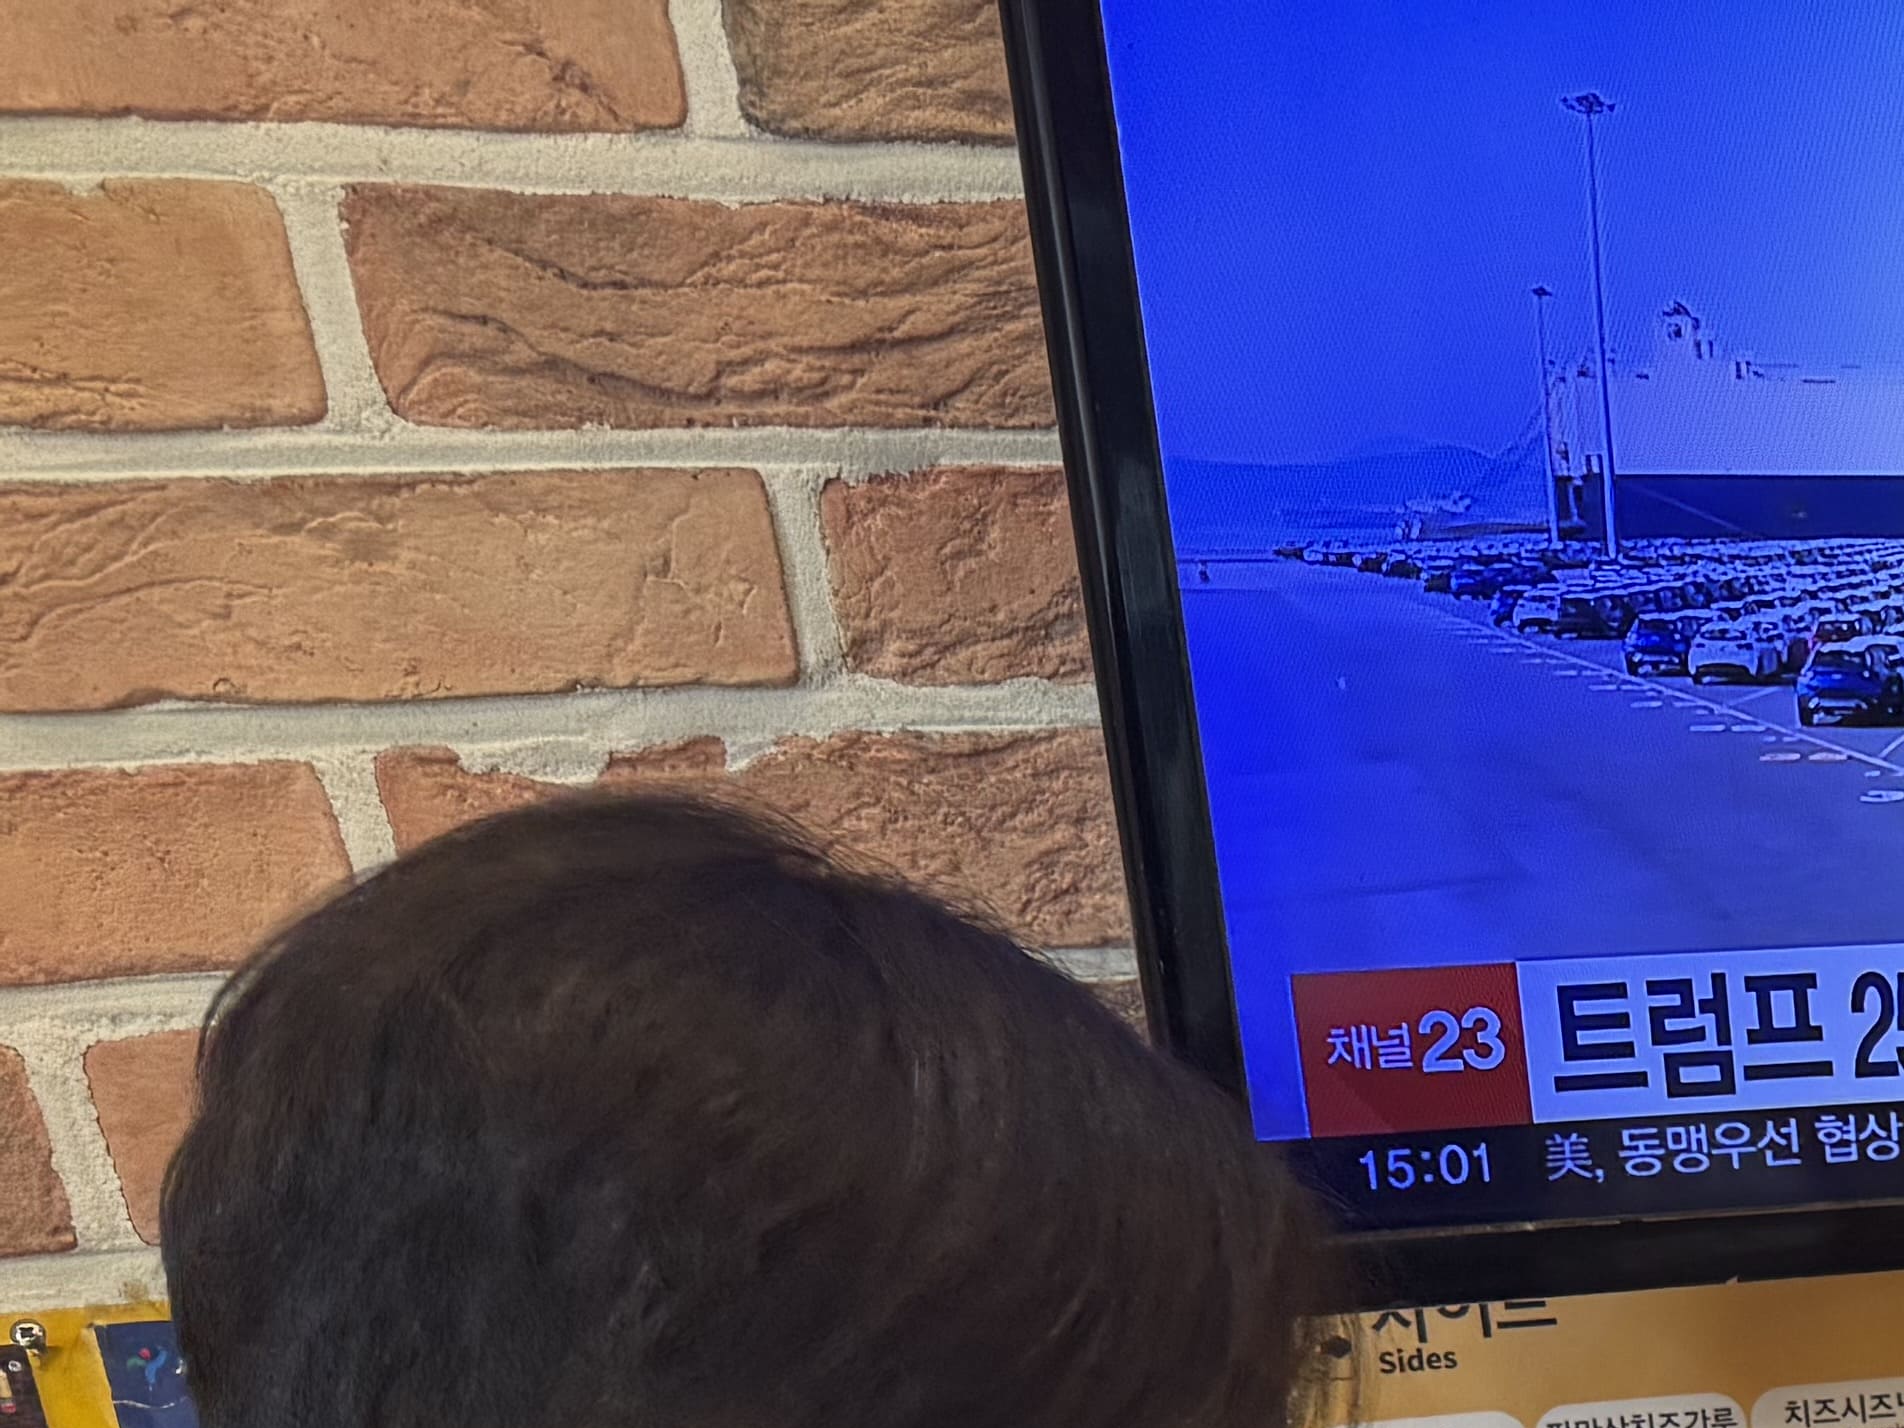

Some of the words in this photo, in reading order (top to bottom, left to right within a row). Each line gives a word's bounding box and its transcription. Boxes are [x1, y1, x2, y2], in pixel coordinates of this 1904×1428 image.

[1554, 972, 1833, 1098] 트럼프
[1359, 1142, 1492, 1190] 15:01
[1545, 1133, 1605, 1183] 美,
[1617, 1118, 1800, 1176] 동맹우선
[1815, 1111, 1903, 1162] 협상
[1379, 1349, 1457, 1374] Sides
